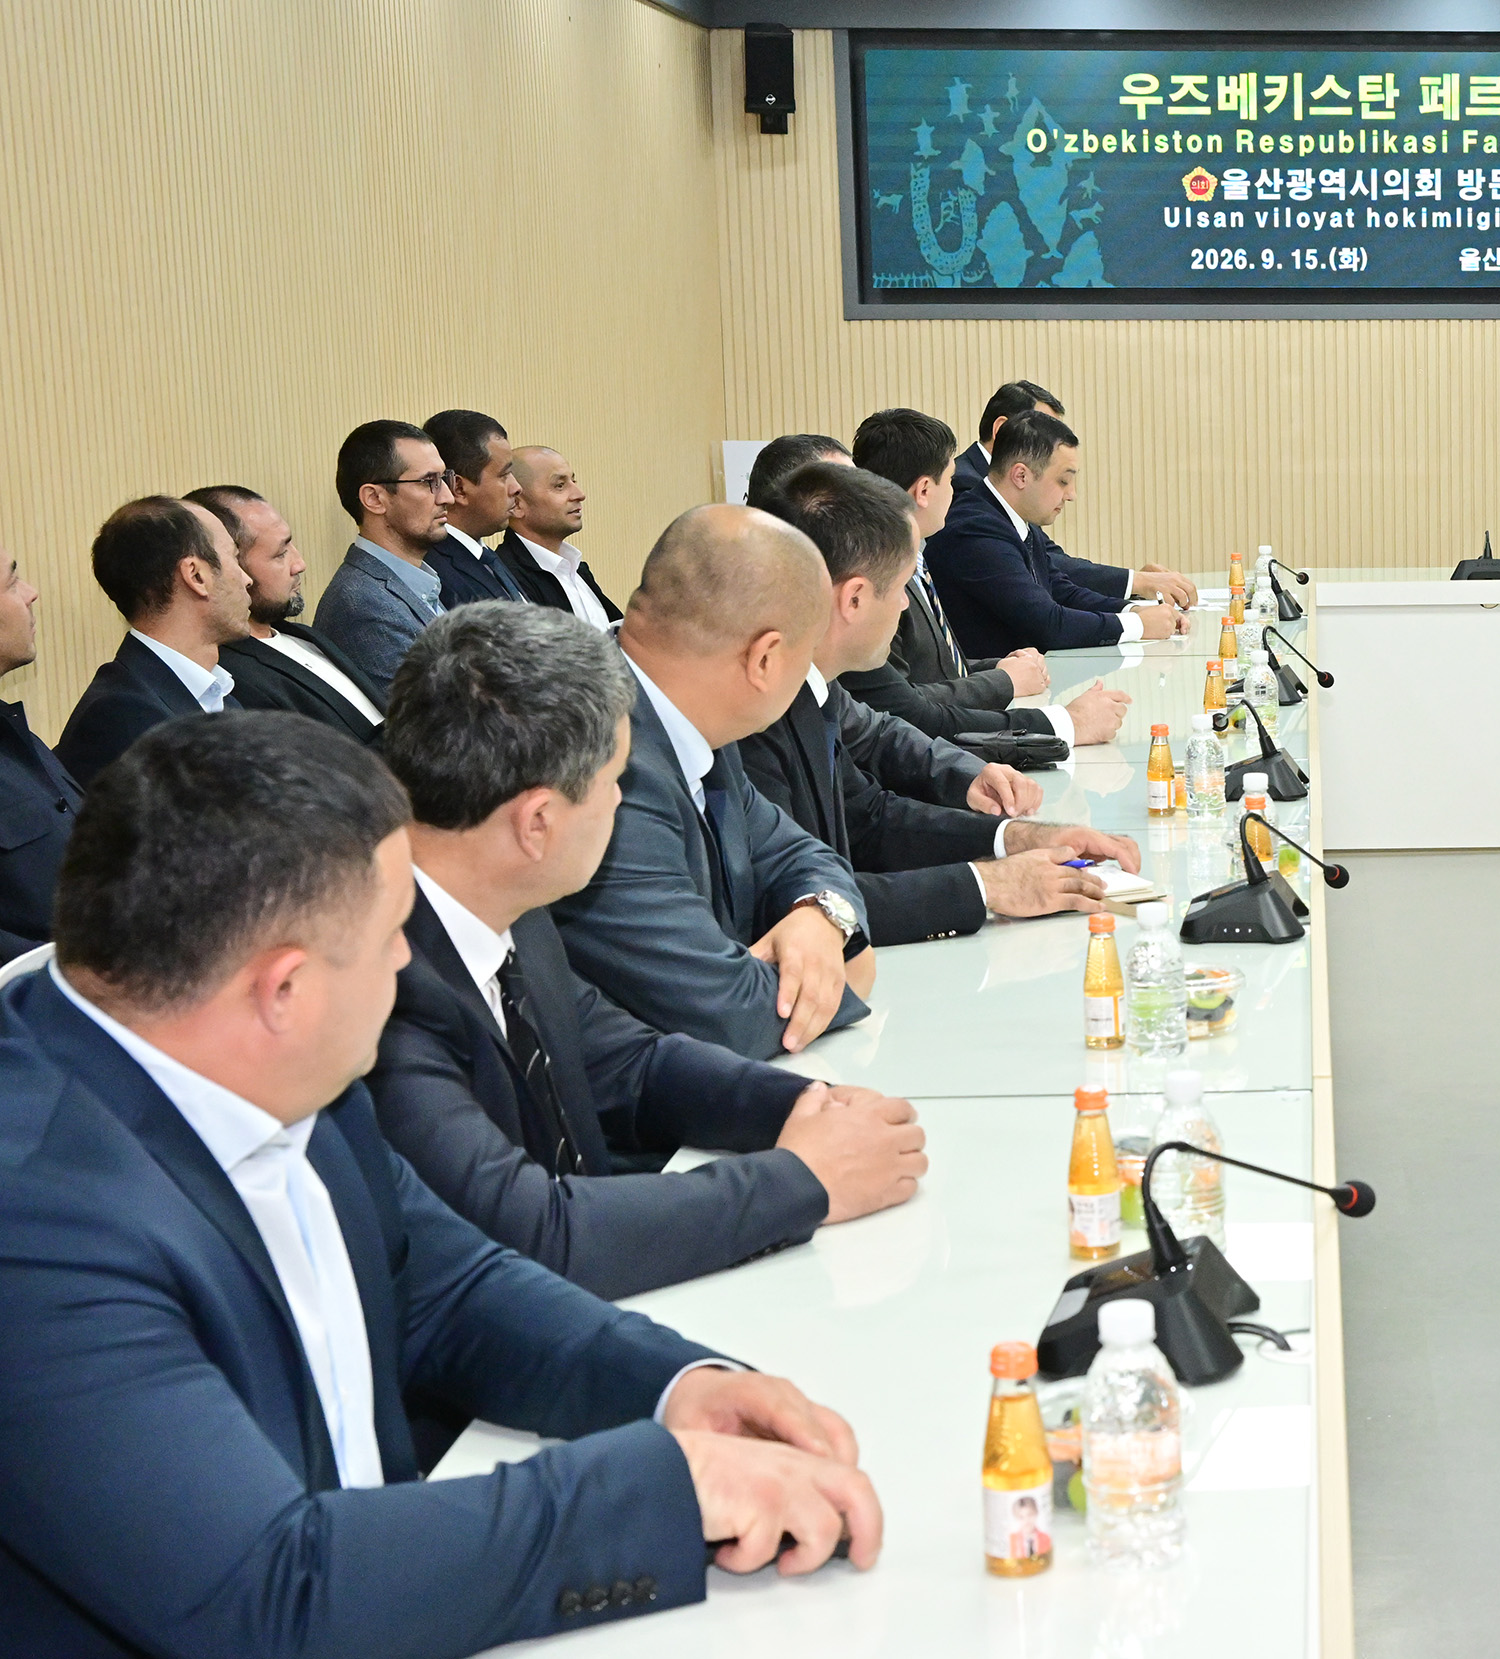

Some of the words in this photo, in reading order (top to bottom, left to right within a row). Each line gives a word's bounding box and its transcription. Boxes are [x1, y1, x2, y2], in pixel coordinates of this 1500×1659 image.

[1117, 71, 1401, 123] 우즈베키스탄
[1025, 128, 1223, 155] O'zbekiston
[1235, 128, 1449, 158] Respublikasi
[1220, 167, 1443, 202] 울산광역시의회
[1163, 205, 1245, 229] Ulsan
[1253, 205, 1356, 233] viloyat
